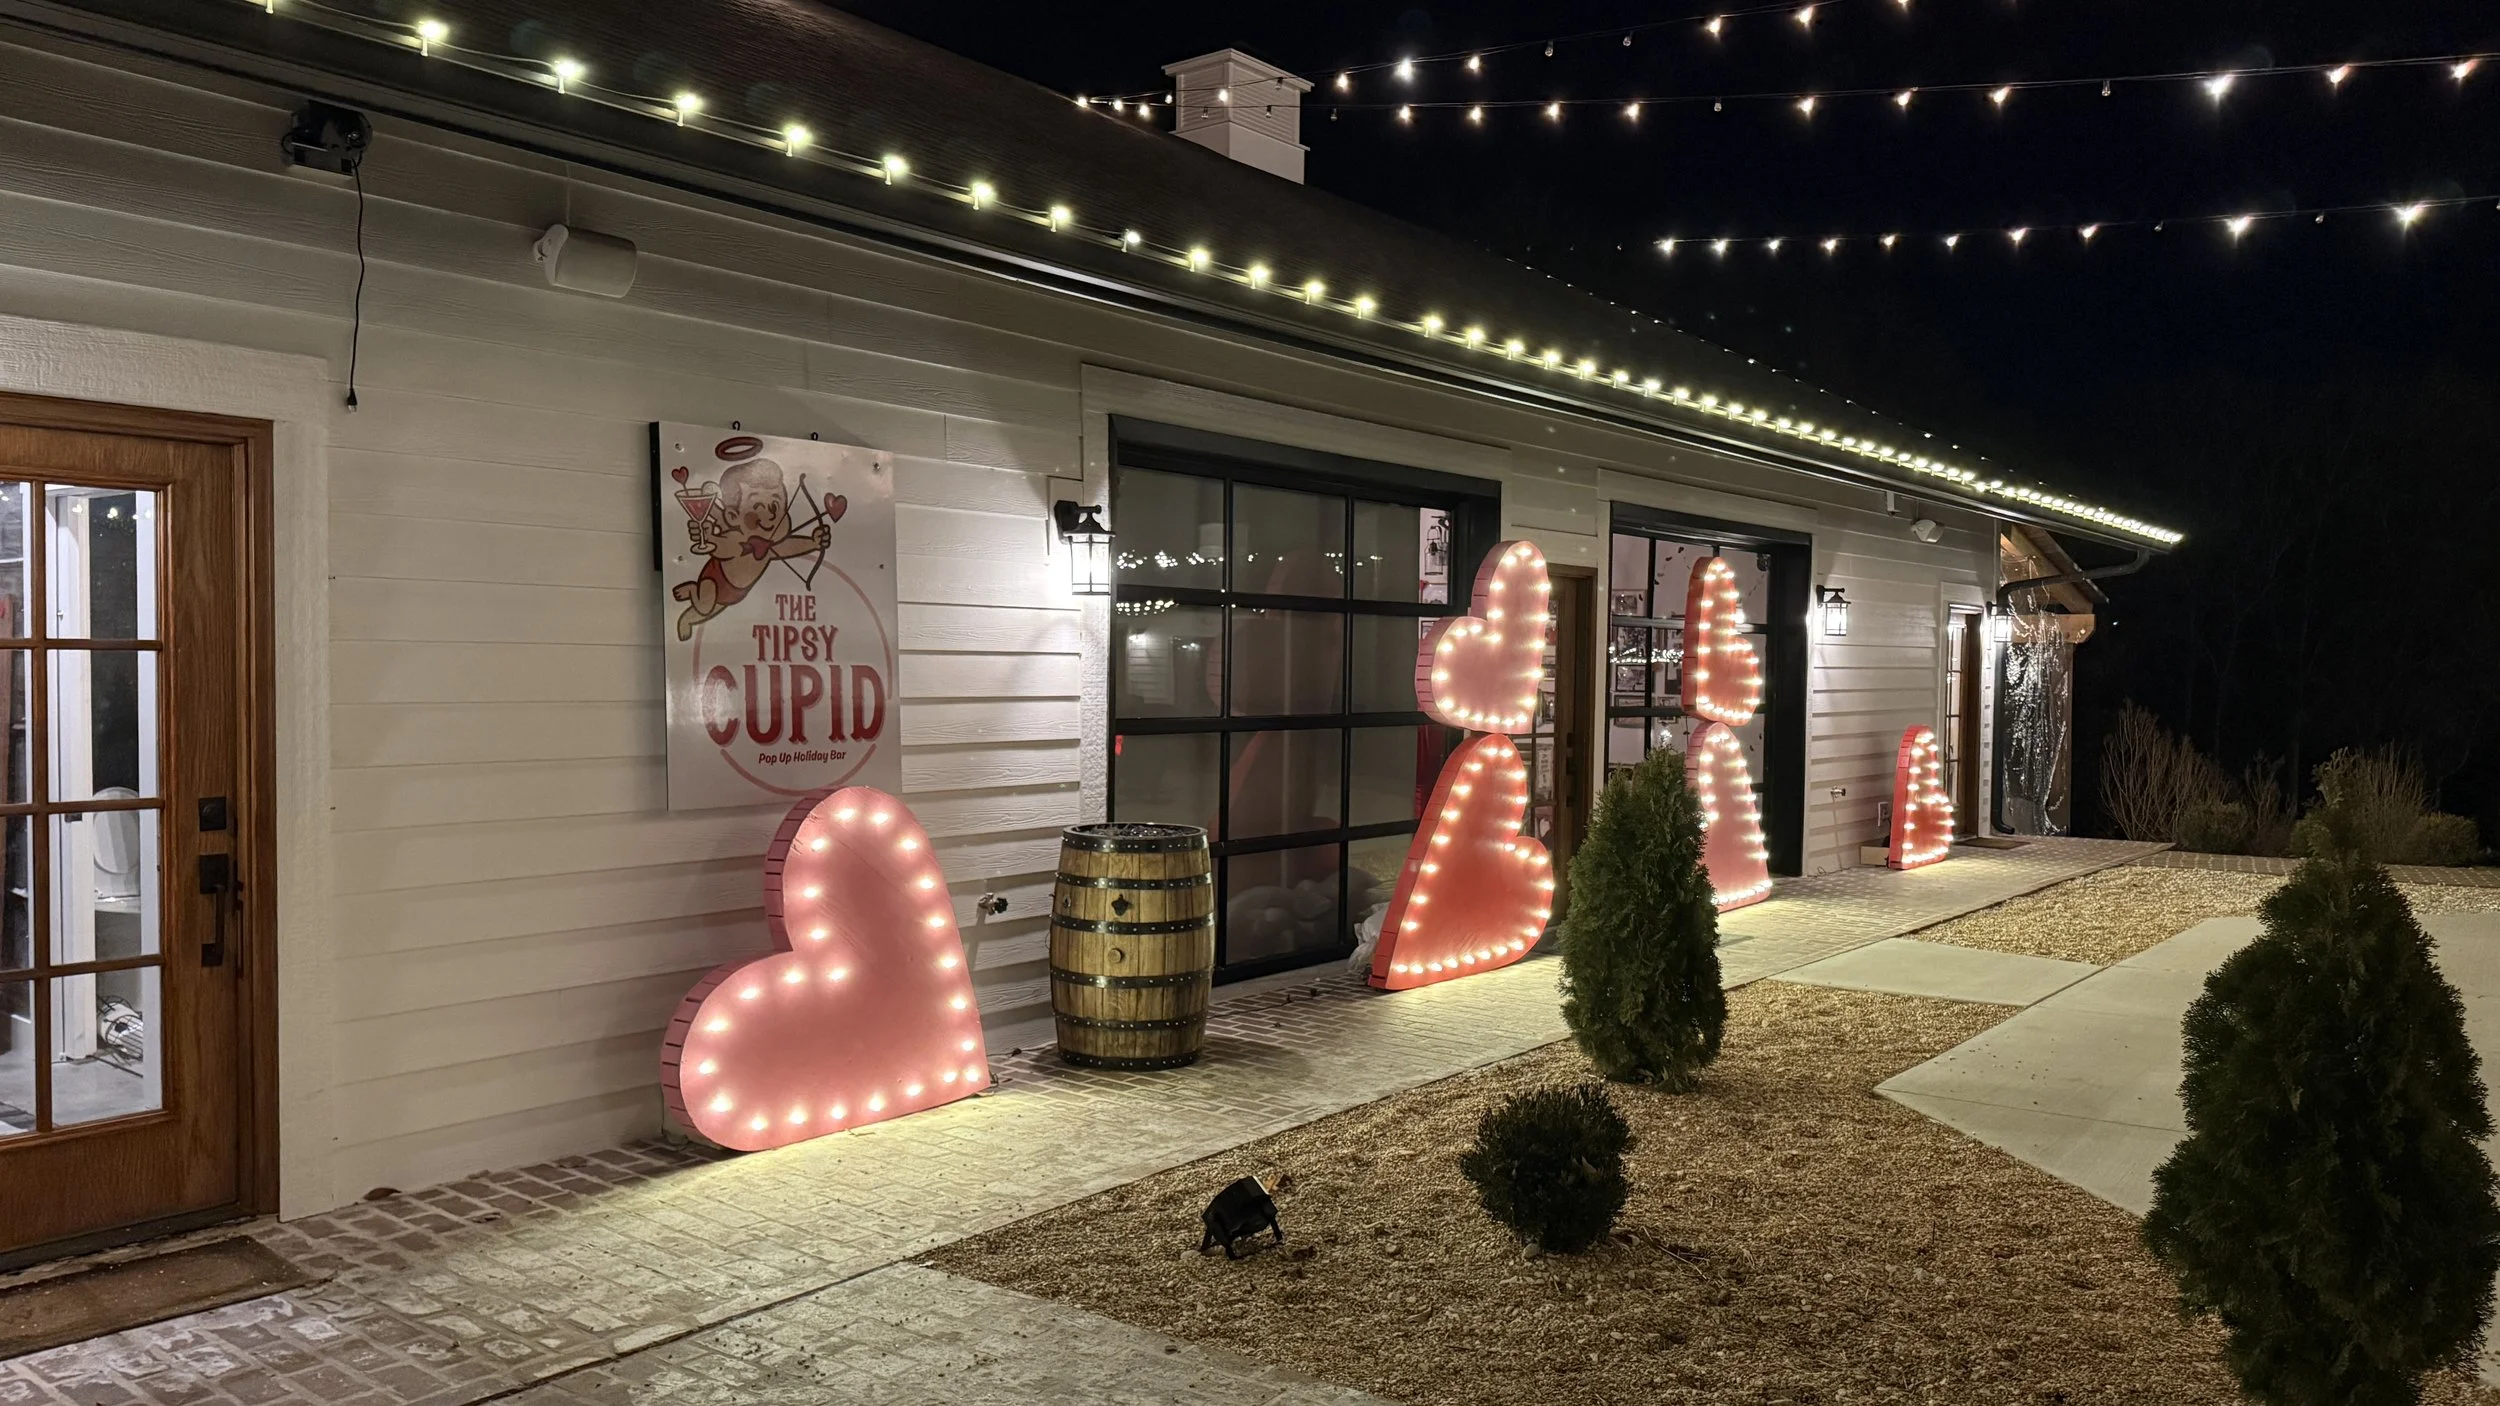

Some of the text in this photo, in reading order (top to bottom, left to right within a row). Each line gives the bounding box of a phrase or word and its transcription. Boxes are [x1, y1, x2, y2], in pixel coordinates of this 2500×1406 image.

[775, 594, 816, 621] THE
[752, 625, 839, 662] TIPSY
[702, 664, 886, 746] CUPID
[758, 749, 847, 765] Pop Up Holiday Bar
